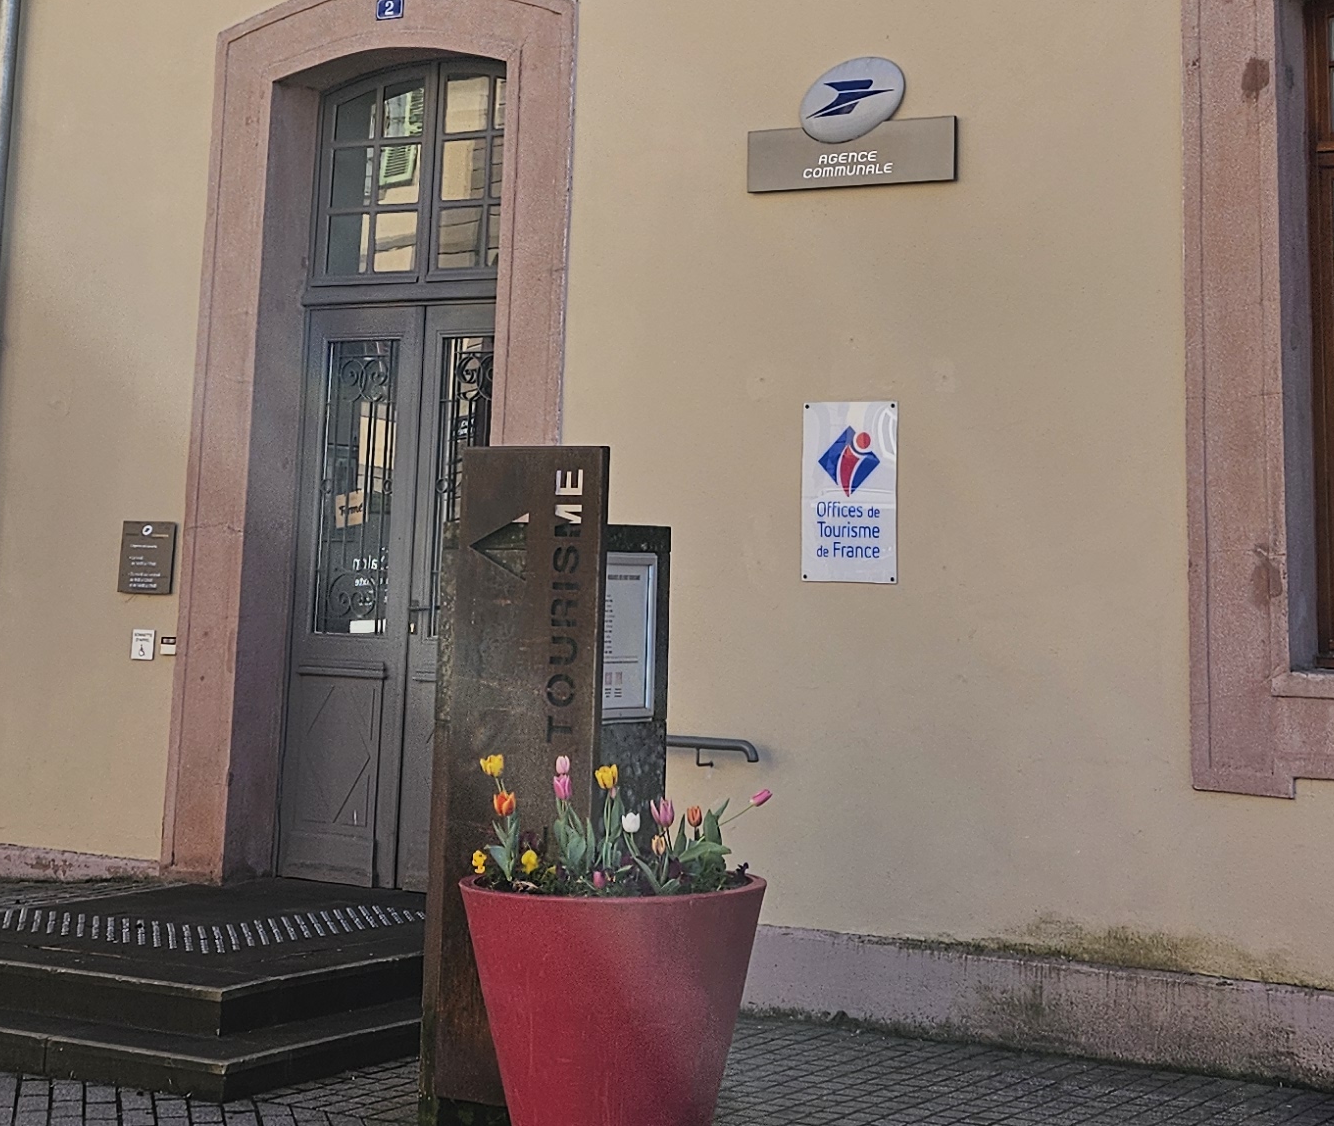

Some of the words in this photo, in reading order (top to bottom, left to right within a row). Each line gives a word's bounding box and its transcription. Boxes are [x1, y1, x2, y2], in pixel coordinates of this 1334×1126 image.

[383, 0, 395, 16] 2
[817, 150, 878, 165] AGENCE
[803, 162, 894, 179] COMMUNALE
[816, 501, 863, 518] Offices
[867, 506, 881, 518] de
[817, 521, 880, 539] Tourisme
[816, 545, 829, 558] de
[833, 542, 880, 558] France
[544, 468, 584, 743] TOURISME
